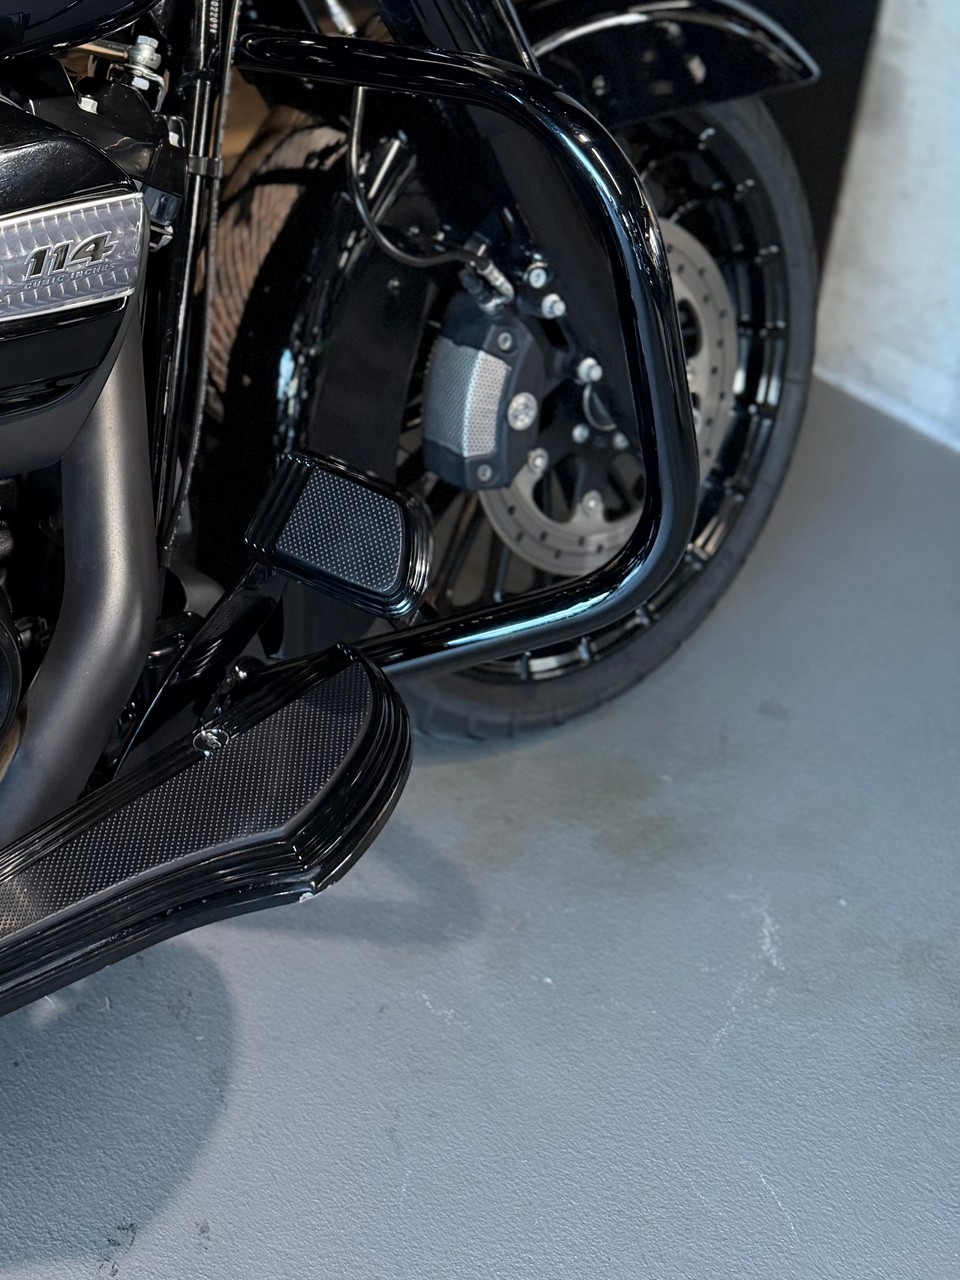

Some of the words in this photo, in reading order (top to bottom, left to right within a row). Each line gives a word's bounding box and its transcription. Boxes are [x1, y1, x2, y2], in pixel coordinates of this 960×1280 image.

[24, 231, 119, 282] 114
[24, 275, 65, 290] CUBIC
[70, 262, 116, 279] INCHES
